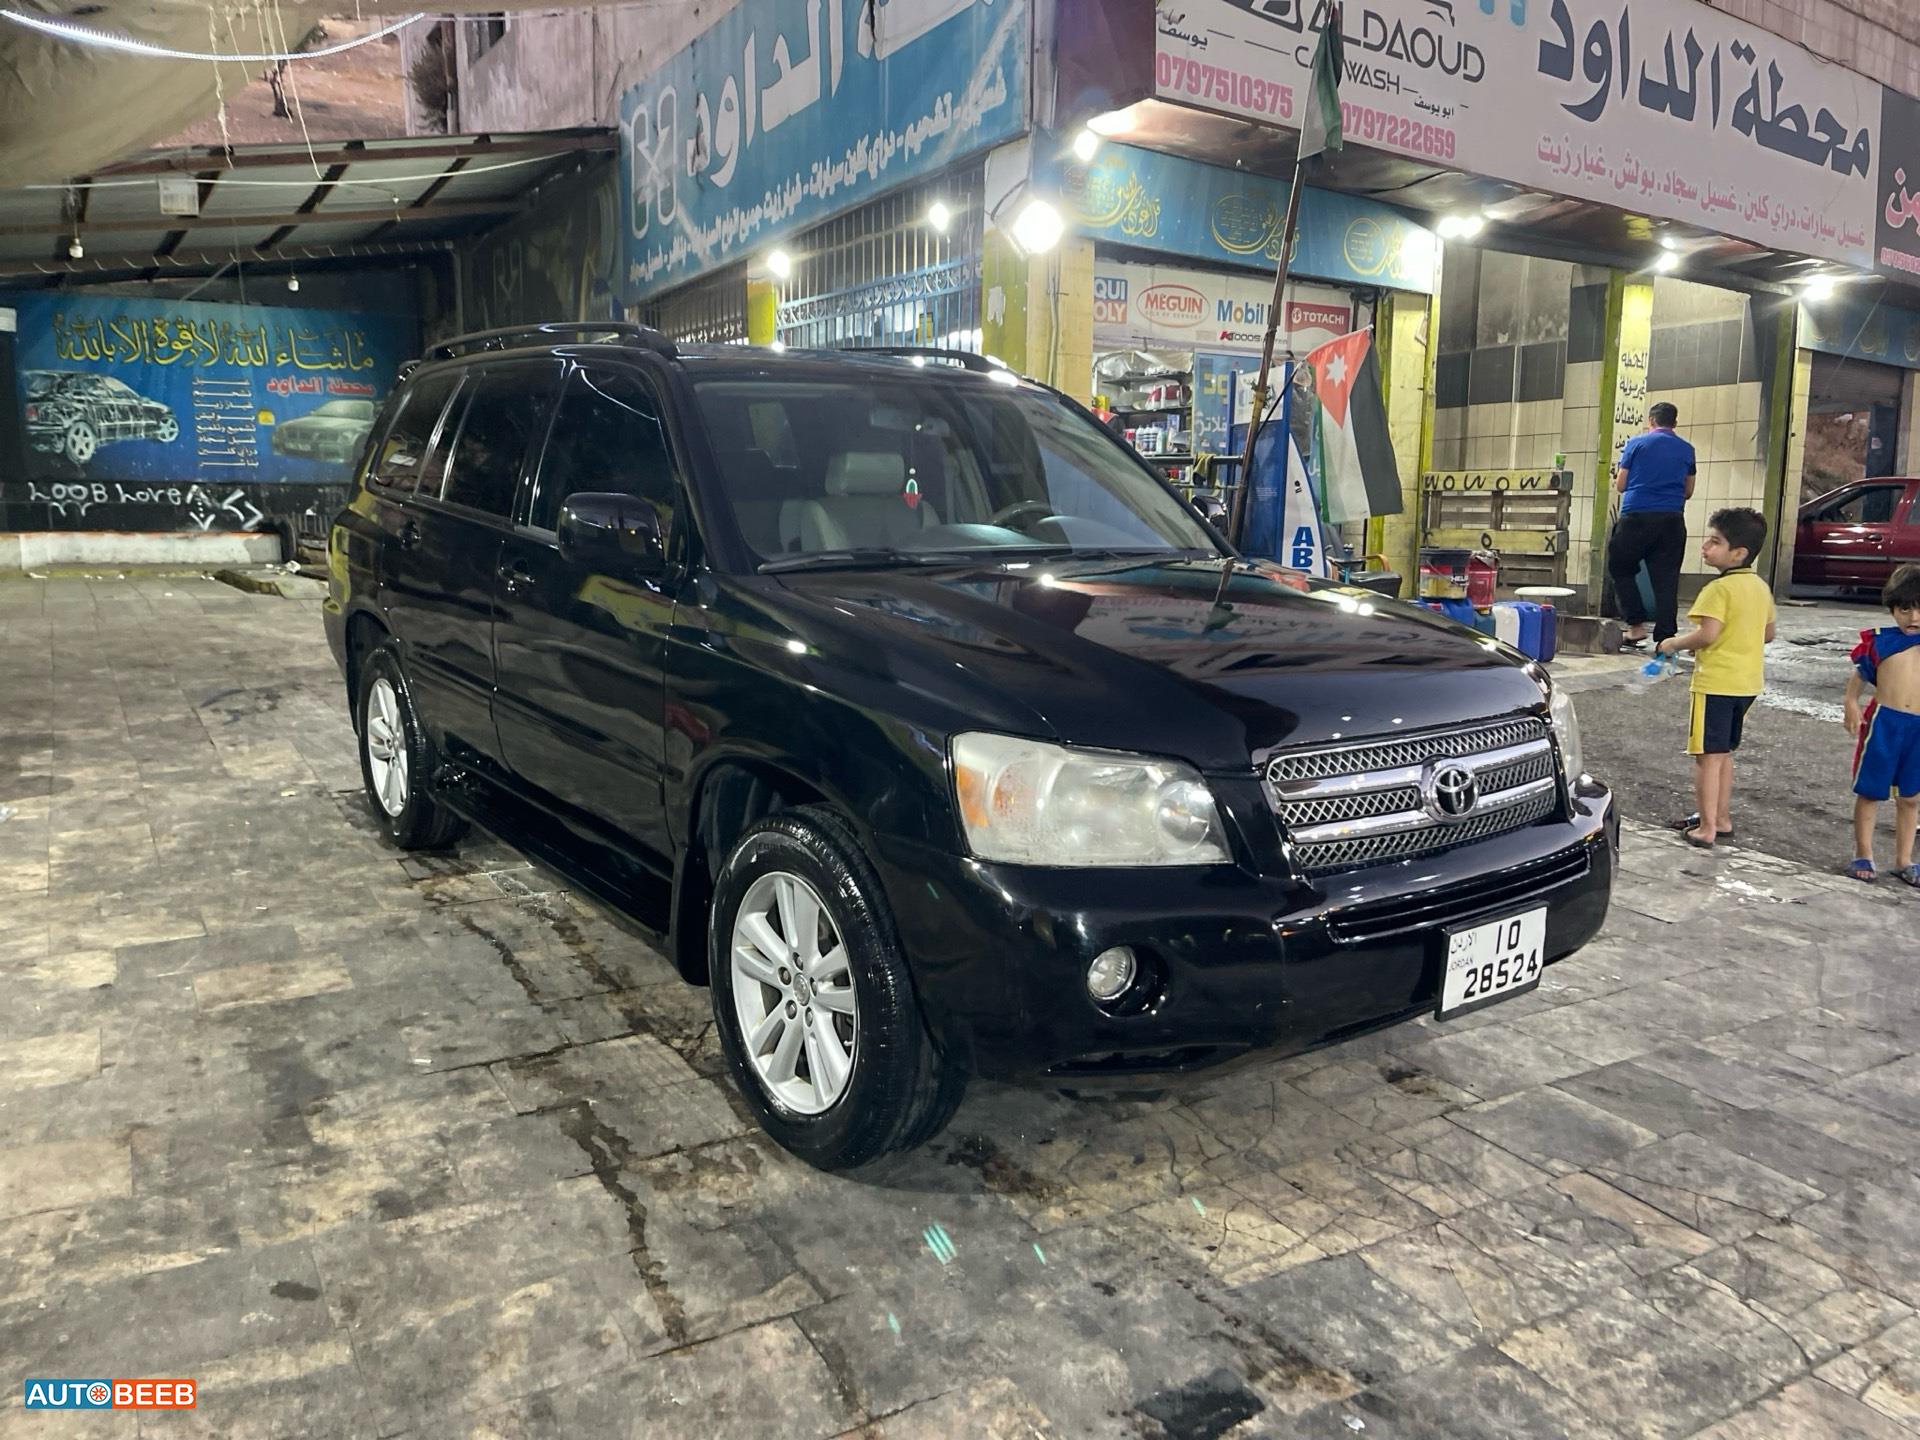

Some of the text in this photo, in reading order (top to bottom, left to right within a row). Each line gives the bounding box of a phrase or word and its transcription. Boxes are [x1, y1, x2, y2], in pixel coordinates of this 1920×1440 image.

[1157, 51, 1293, 119] 0797510375
[1343, 59, 1400, 94] WASH
[1537, 0, 1871, 180] محطة الداود
[1340, 101, 1456, 160] 0797222659
[1217, 299, 1264, 325] Mobil
[1303, 311, 1345, 325] TOTACHI
[1496, 919, 1521, 955] 10
[1463, 948, 1538, 999] 28524
